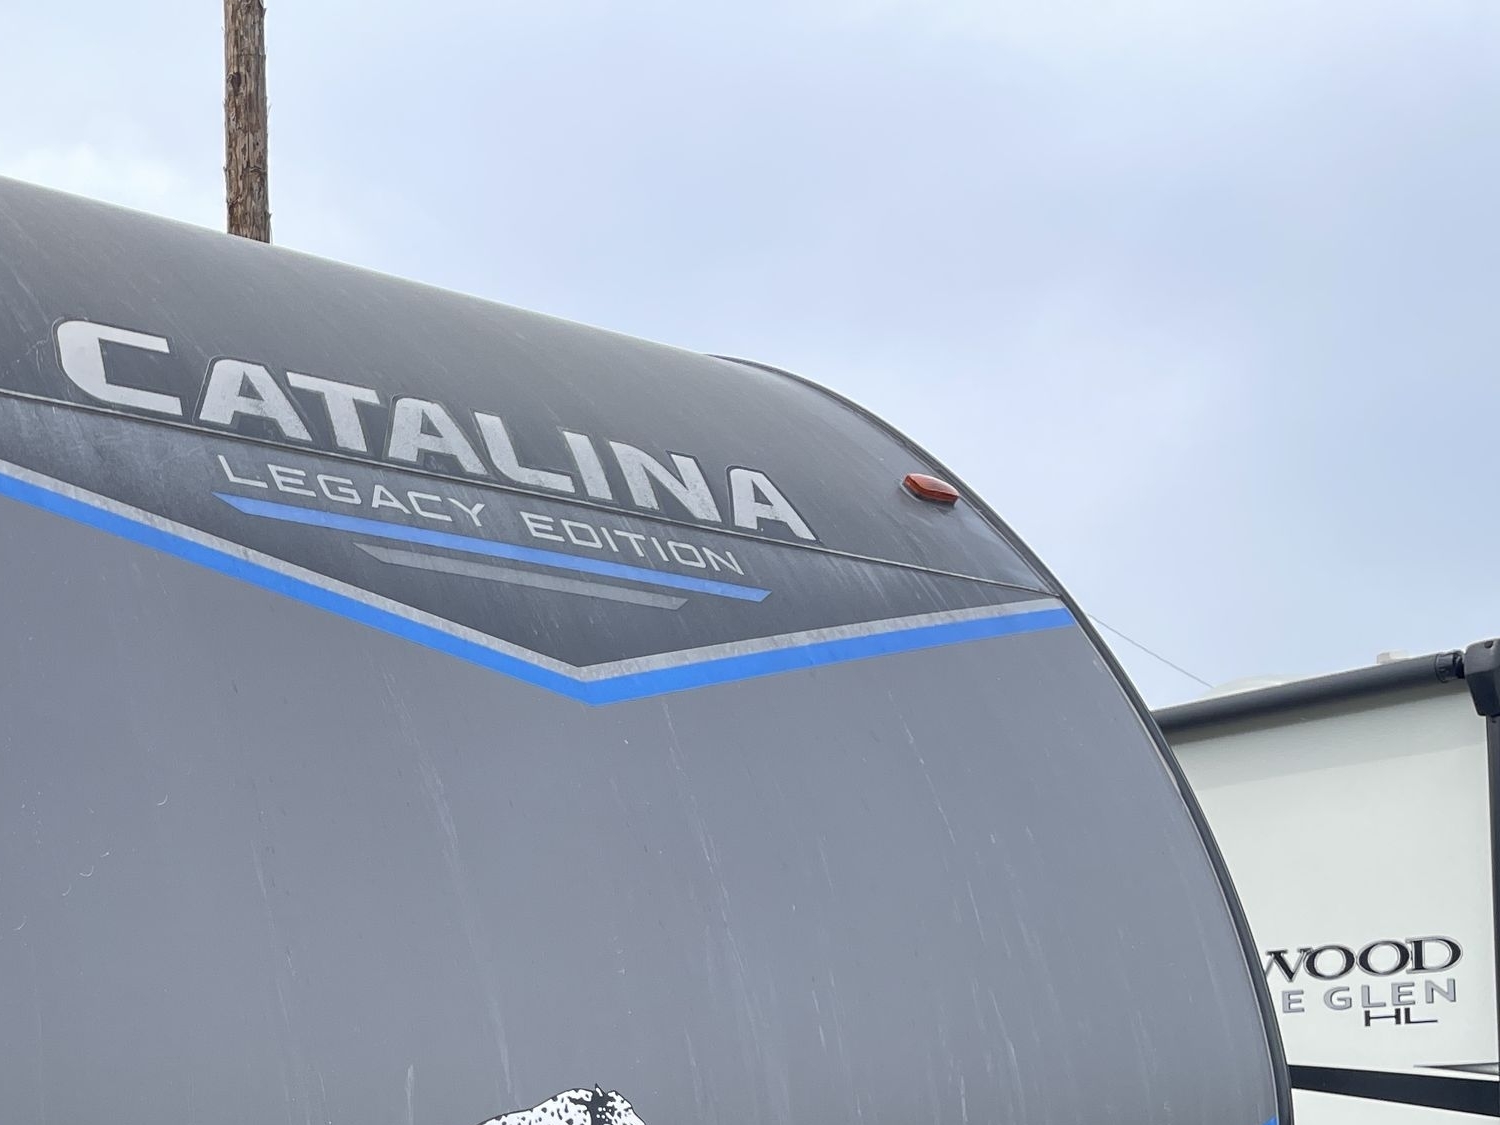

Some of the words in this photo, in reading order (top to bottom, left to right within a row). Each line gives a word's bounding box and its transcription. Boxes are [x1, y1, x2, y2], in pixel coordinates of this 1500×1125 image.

[55, 319, 817, 541] CATALINA
[219, 455, 486, 528] LEGACY
[521, 515, 745, 576] EDITION
[1323, 978, 1456, 1010] GLEN
[1364, 1007, 1438, 1026] HL
